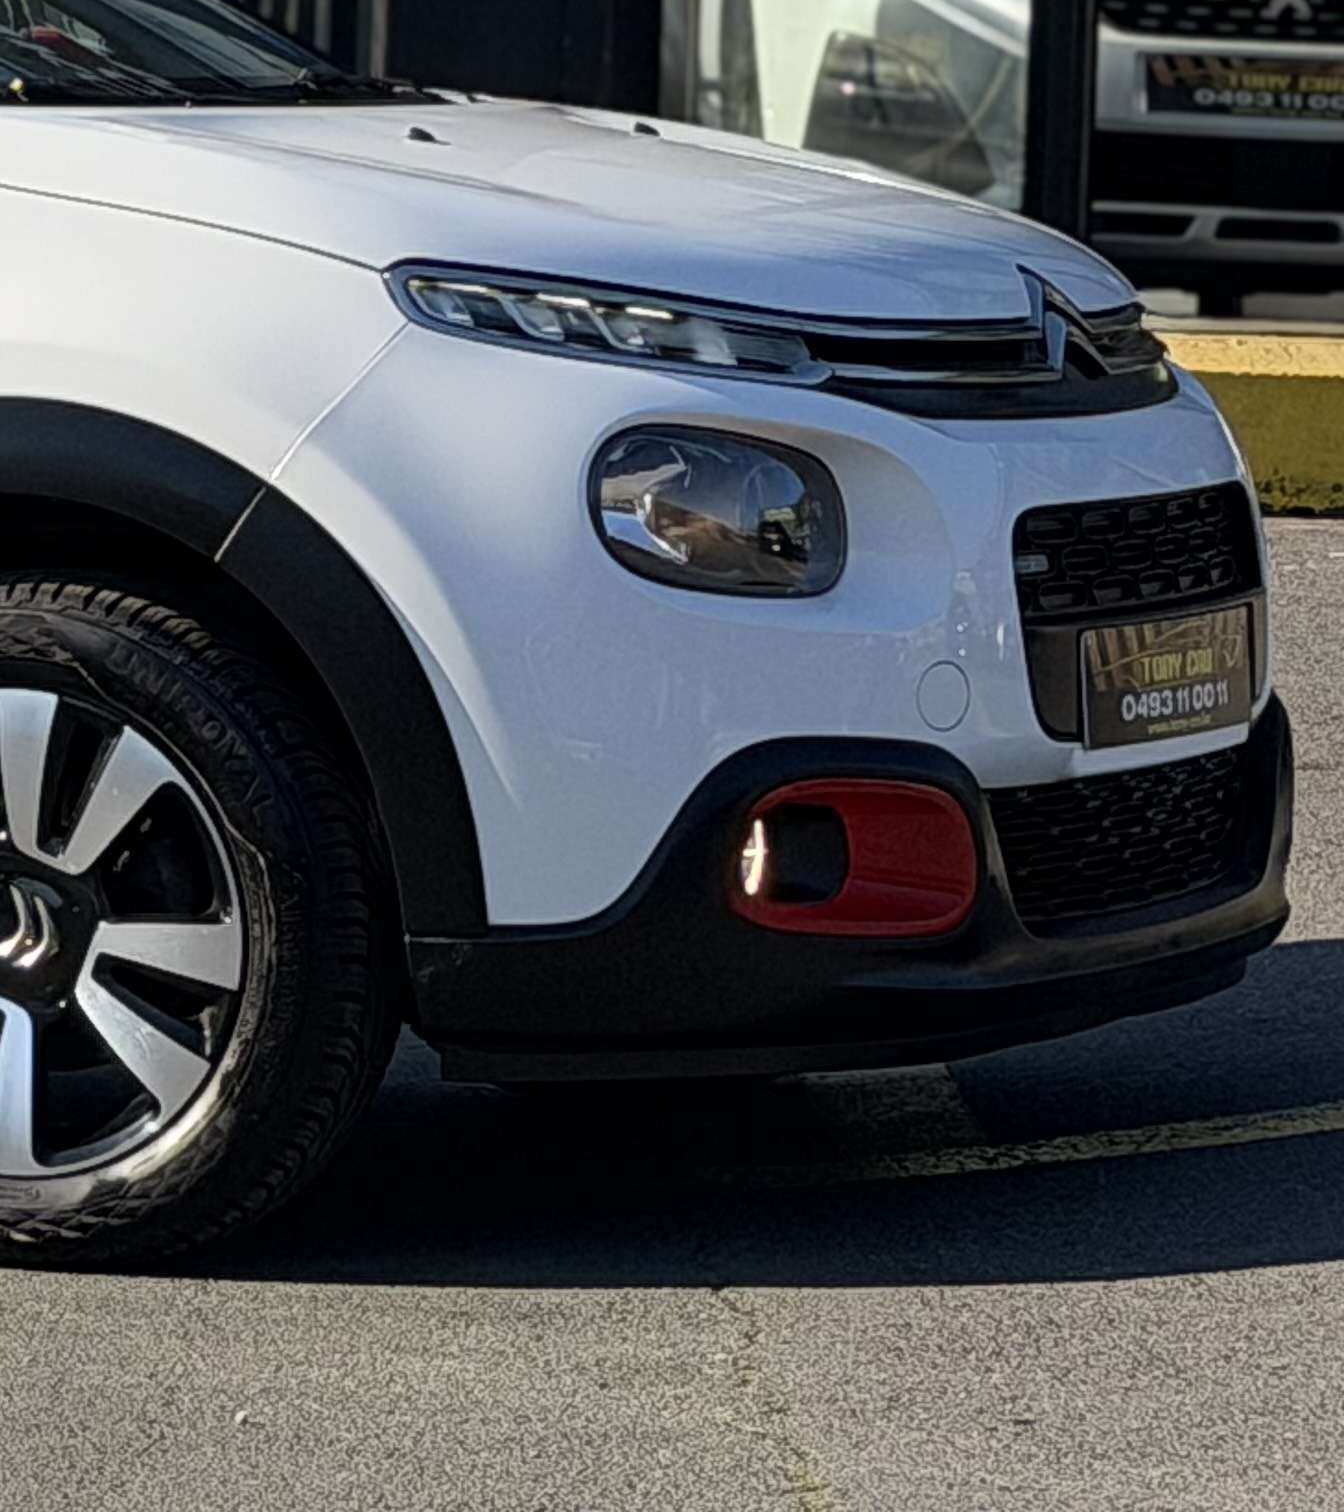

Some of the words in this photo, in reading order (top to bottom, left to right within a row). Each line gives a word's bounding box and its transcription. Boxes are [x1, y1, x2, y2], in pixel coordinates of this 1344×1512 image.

[1139, 652, 1182, 684] TONY
[1121, 689, 1173, 721] 0493
[1176, 687, 1190, 713] 11
[1192, 683, 1214, 710] 00
[1216, 679, 1229, 706] 11
